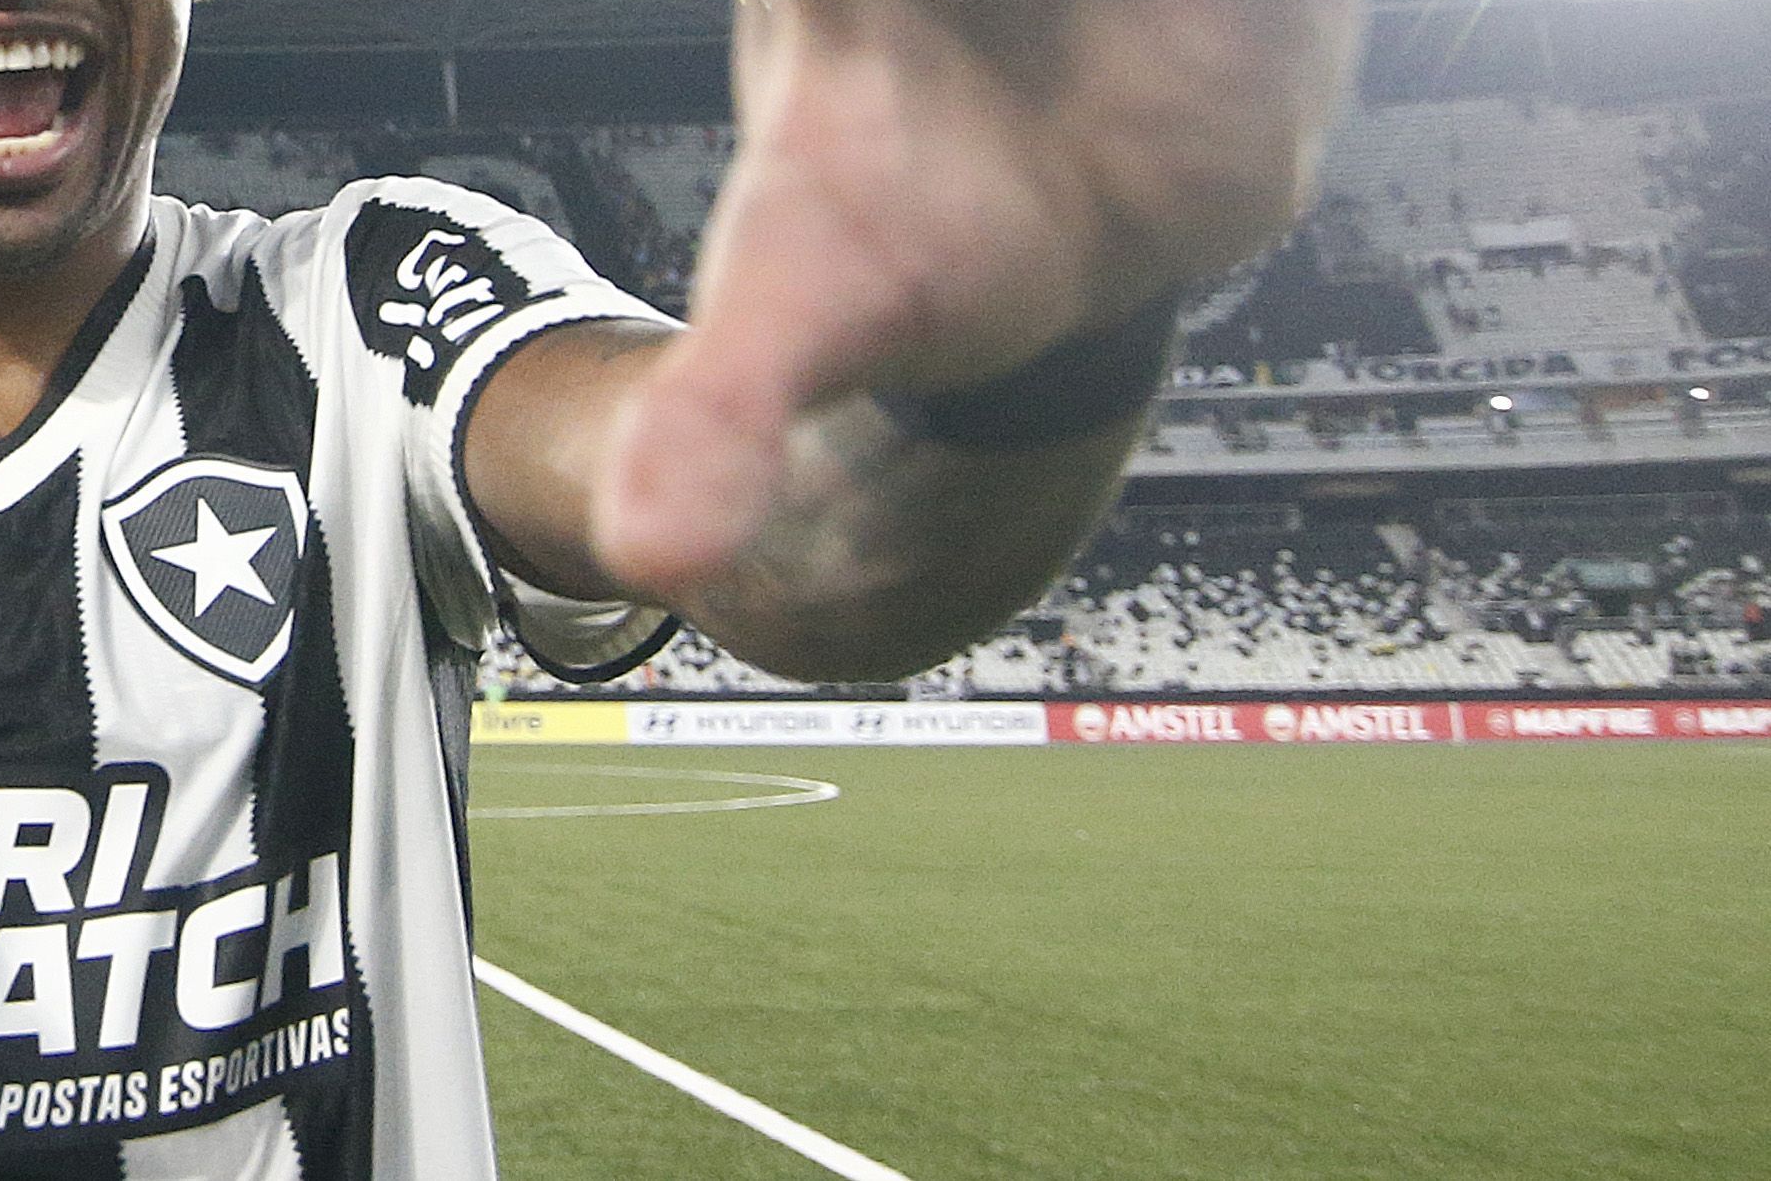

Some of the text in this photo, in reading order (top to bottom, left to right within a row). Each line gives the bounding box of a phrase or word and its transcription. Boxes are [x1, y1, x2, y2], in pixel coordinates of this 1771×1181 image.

[1109, 705, 1244, 741] AMSTEL
[1300, 705, 1434, 741] AMSTEL
[1512, 707, 1655, 735] MAPFRE
[158, 1008, 351, 1113] ESPORTIVAS
